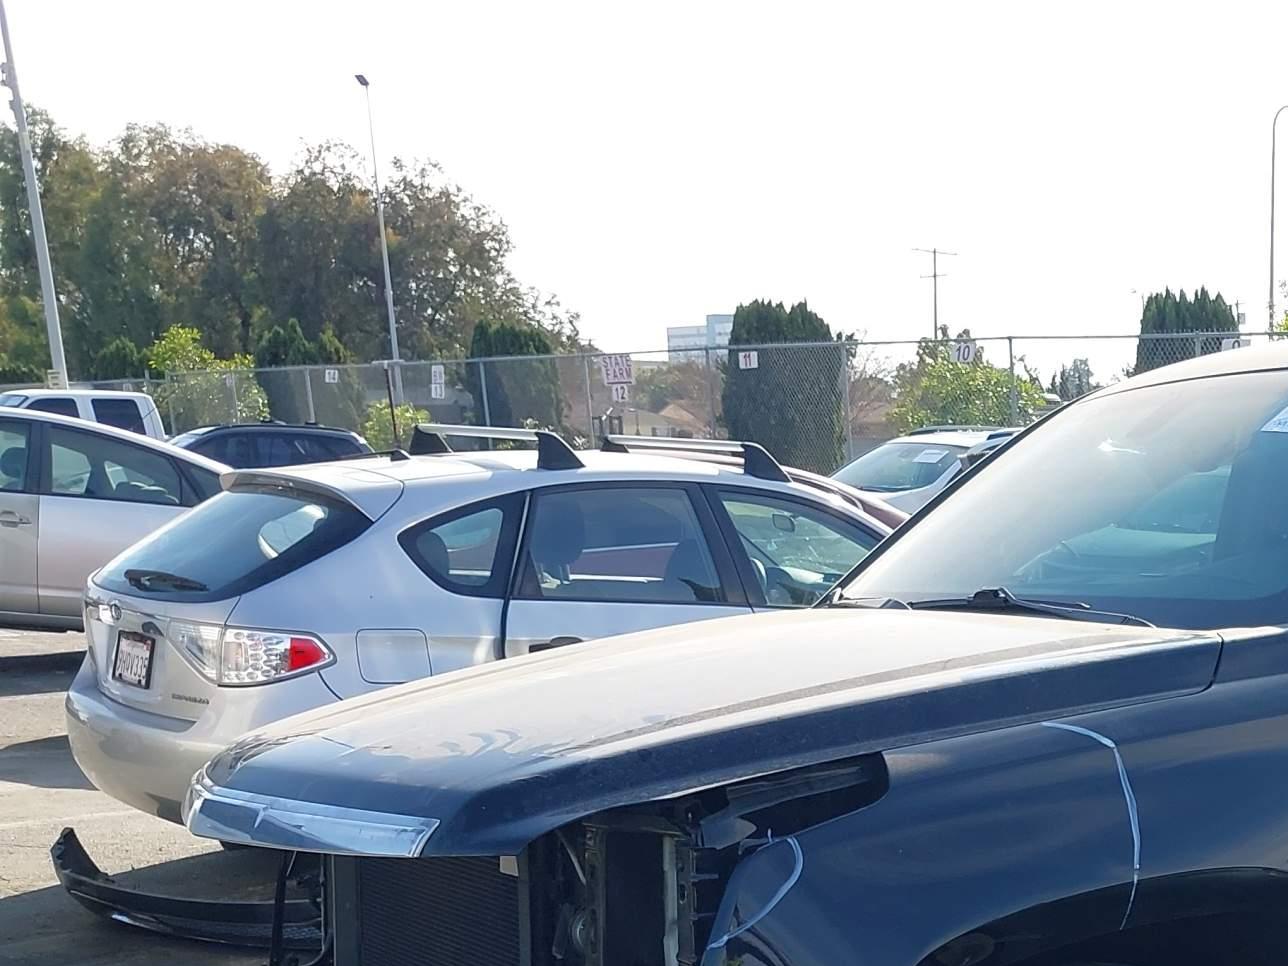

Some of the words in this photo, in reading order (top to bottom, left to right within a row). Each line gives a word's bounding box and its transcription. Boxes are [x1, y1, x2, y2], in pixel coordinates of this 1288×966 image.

[744, 353, 751, 367] 11
[956, 345, 970, 361] 10
[602, 355, 632, 368] STATE
[606, 368, 632, 380] FARM
[615, 386, 626, 400] 12
